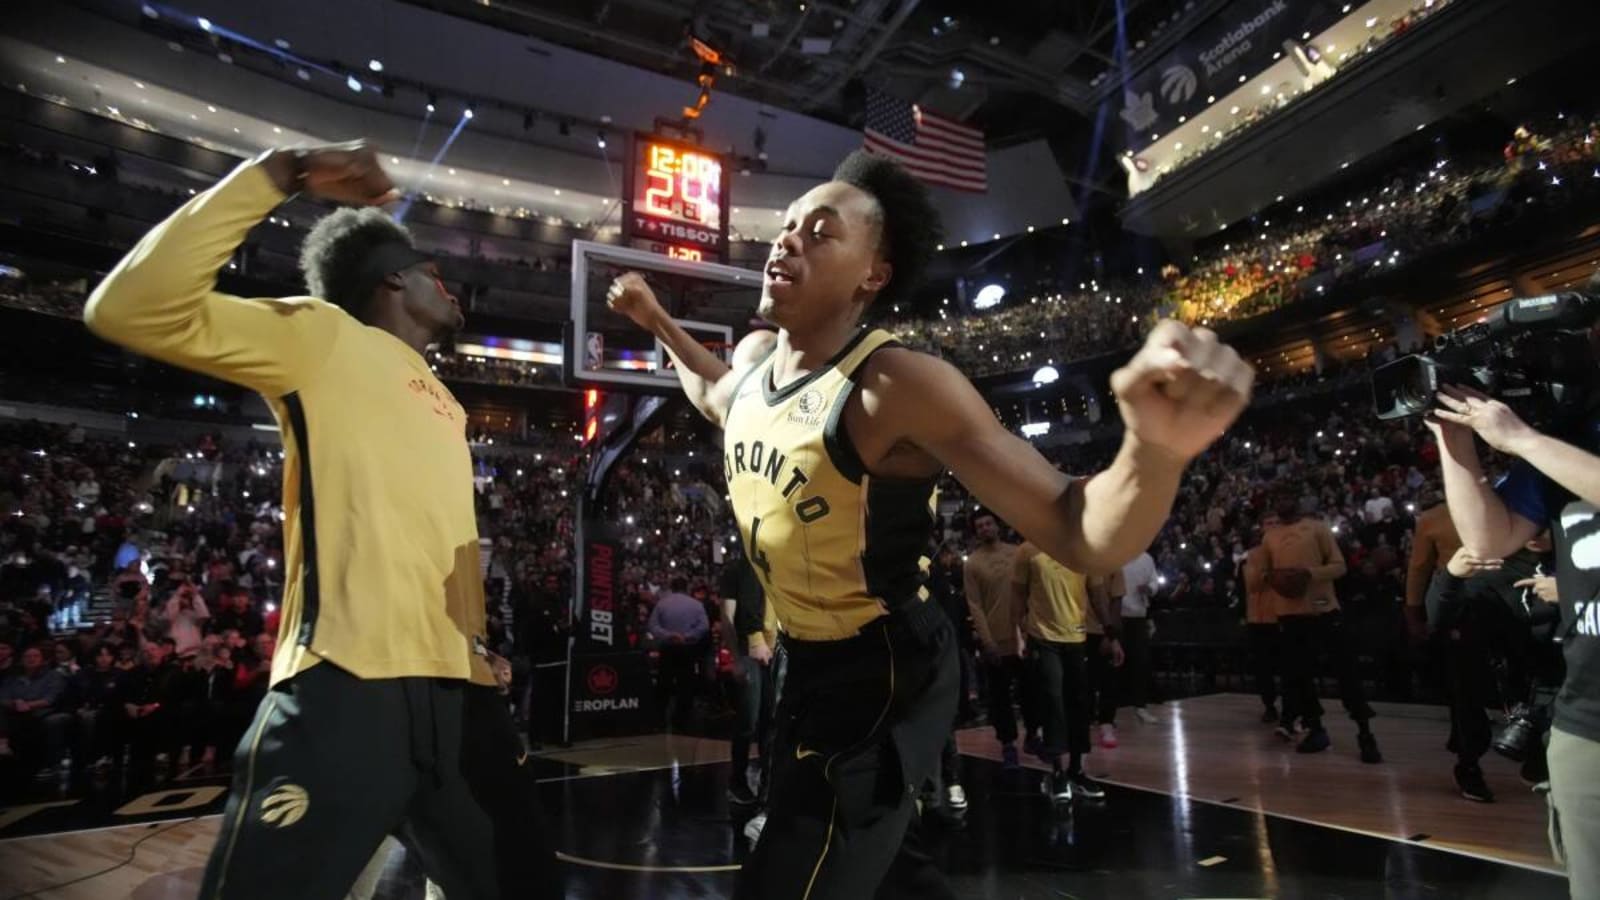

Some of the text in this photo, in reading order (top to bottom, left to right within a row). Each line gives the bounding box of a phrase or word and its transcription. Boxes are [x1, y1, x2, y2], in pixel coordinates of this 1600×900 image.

[1198, 0, 1287, 65] Scotiabank
[1207, 40, 1252, 77] Arena
[660, 222, 720, 245] TISSOT
[787, 411, 821, 426] Sun Life
[590, 543, 614, 646] POINTSBET
[575, 698, 639, 712] EROPLAN
